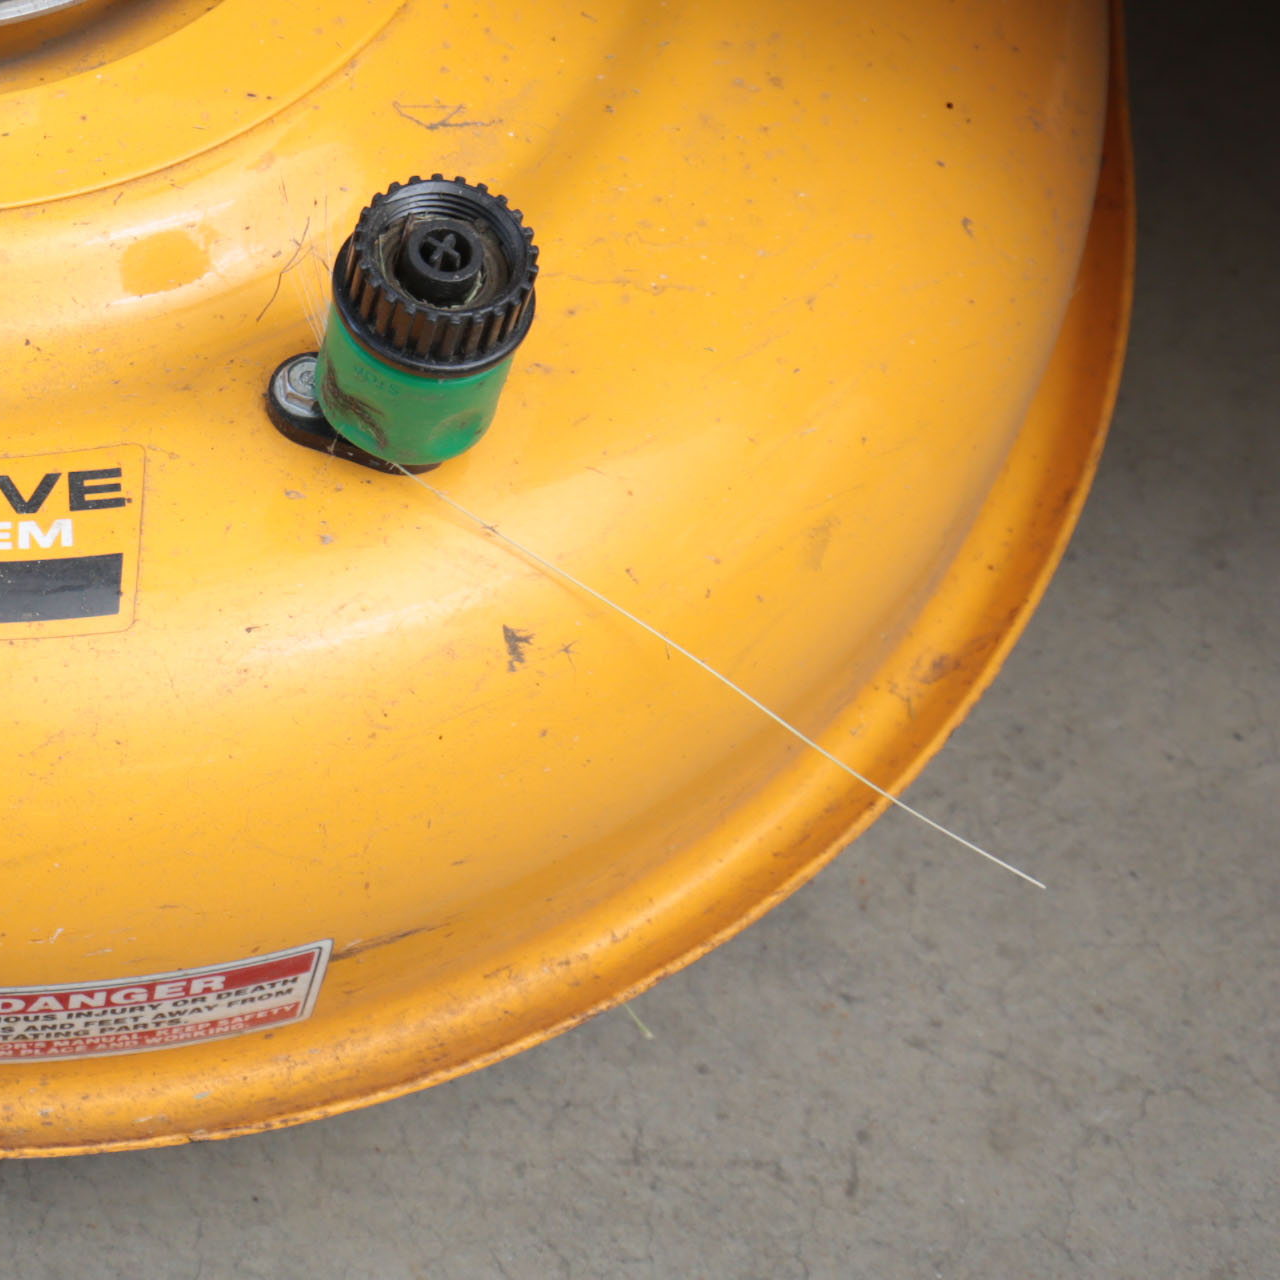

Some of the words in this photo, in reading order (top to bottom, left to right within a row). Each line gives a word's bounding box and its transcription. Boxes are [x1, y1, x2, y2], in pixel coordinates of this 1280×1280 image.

[24, 1022, 75, 1032] AND
[84, 1015, 145, 1027] FEET
[151, 1004, 219, 1020] AWAY
[226, 987, 294, 1008] FROM
[67, 1003, 162, 1020] INJURY
[172, 995, 207, 1007] OR
[216, 976, 299, 1000] DEATH
